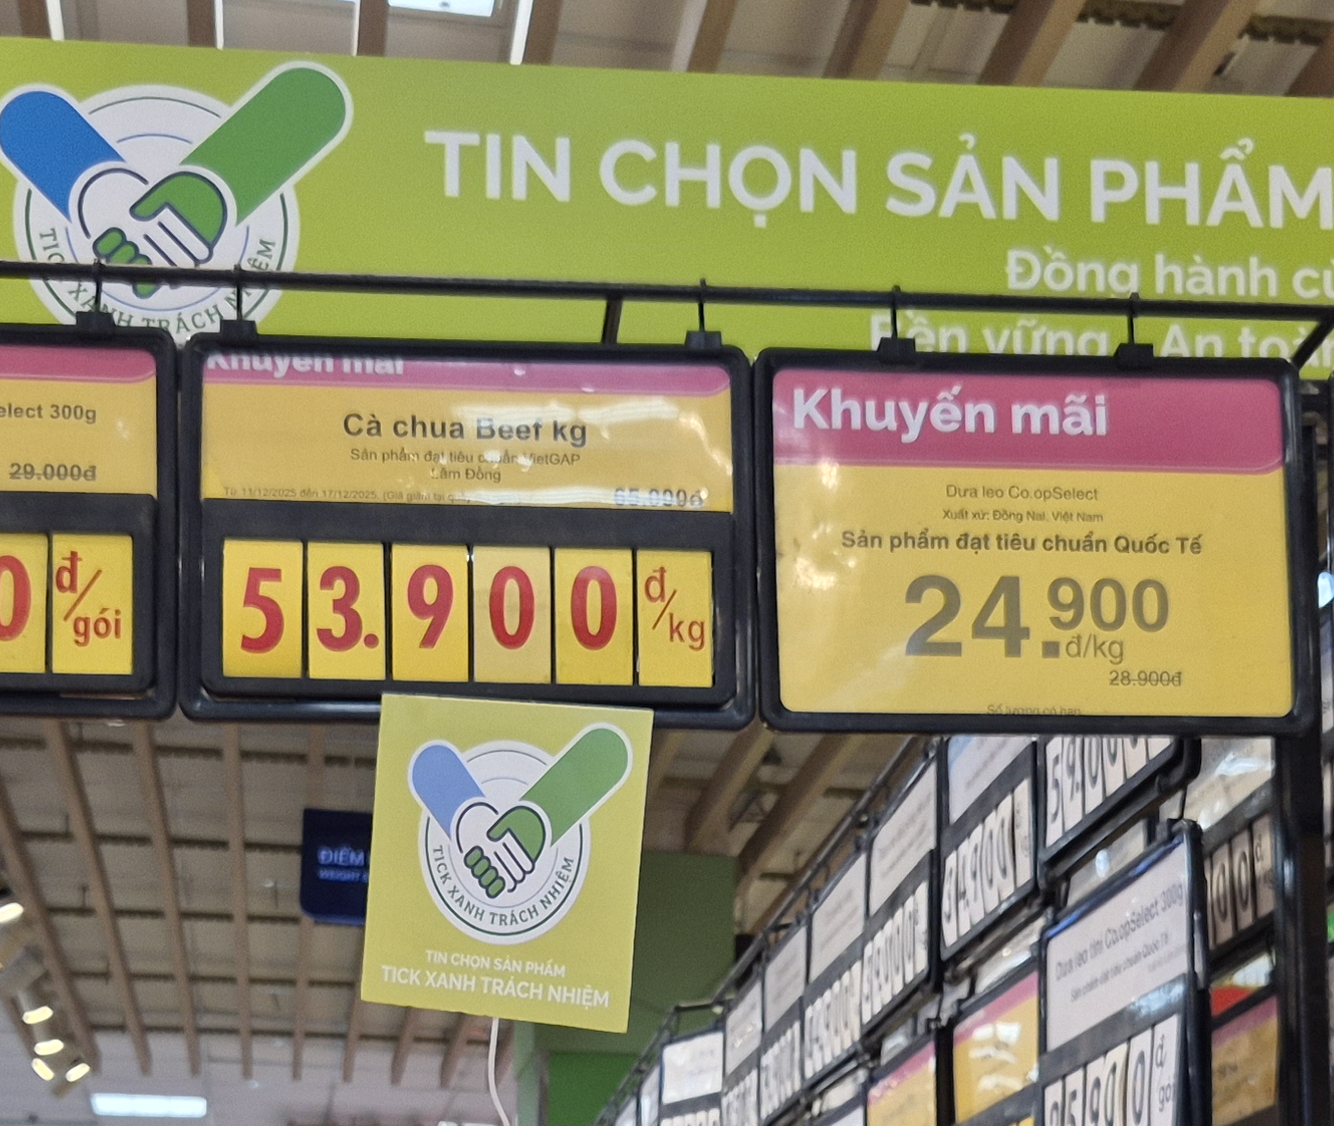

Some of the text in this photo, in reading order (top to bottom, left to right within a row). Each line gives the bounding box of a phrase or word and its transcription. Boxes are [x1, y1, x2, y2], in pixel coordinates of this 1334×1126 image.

[424, 130, 571, 203] TIN
[598, 138, 858, 229] CHỌN
[884, 132, 1060, 223] SẢN
[1088, 136, 1334, 231] PHẨM
[1004, 244, 1139, 301] Đồng
[1153, 252, 1278, 297] hành
[49, 404, 98, 424] 300g
[342, 412, 588, 448] Cà chua Beef kg
[792, 384, 1110, 444] Khuyến mãi
[349, 447, 378, 462] Sản
[464, 467, 502, 483] Đồng
[945, 484, 979, 500] Dưa
[981, 484, 1005, 500] leo
[840, 528, 1203, 556] Sản phẩm đạt tiêu chuẩn Quốc Tế
[54, 549, 123, 648] đ/gói
[239, 563, 707, 654] 53.900 đ/kg
[904, 573, 1169, 660] 24.900
[1065, 634, 1126, 665] đ/kg
[1107, 669, 1183, 688] 28.900đ
[424, 949, 449, 964] TIN
[450, 952, 492, 972] CHỌN
[493, 953, 523, 974] SẢN
[380, 964, 611, 1011] TICK XANH TRÁCH NHIỆM
